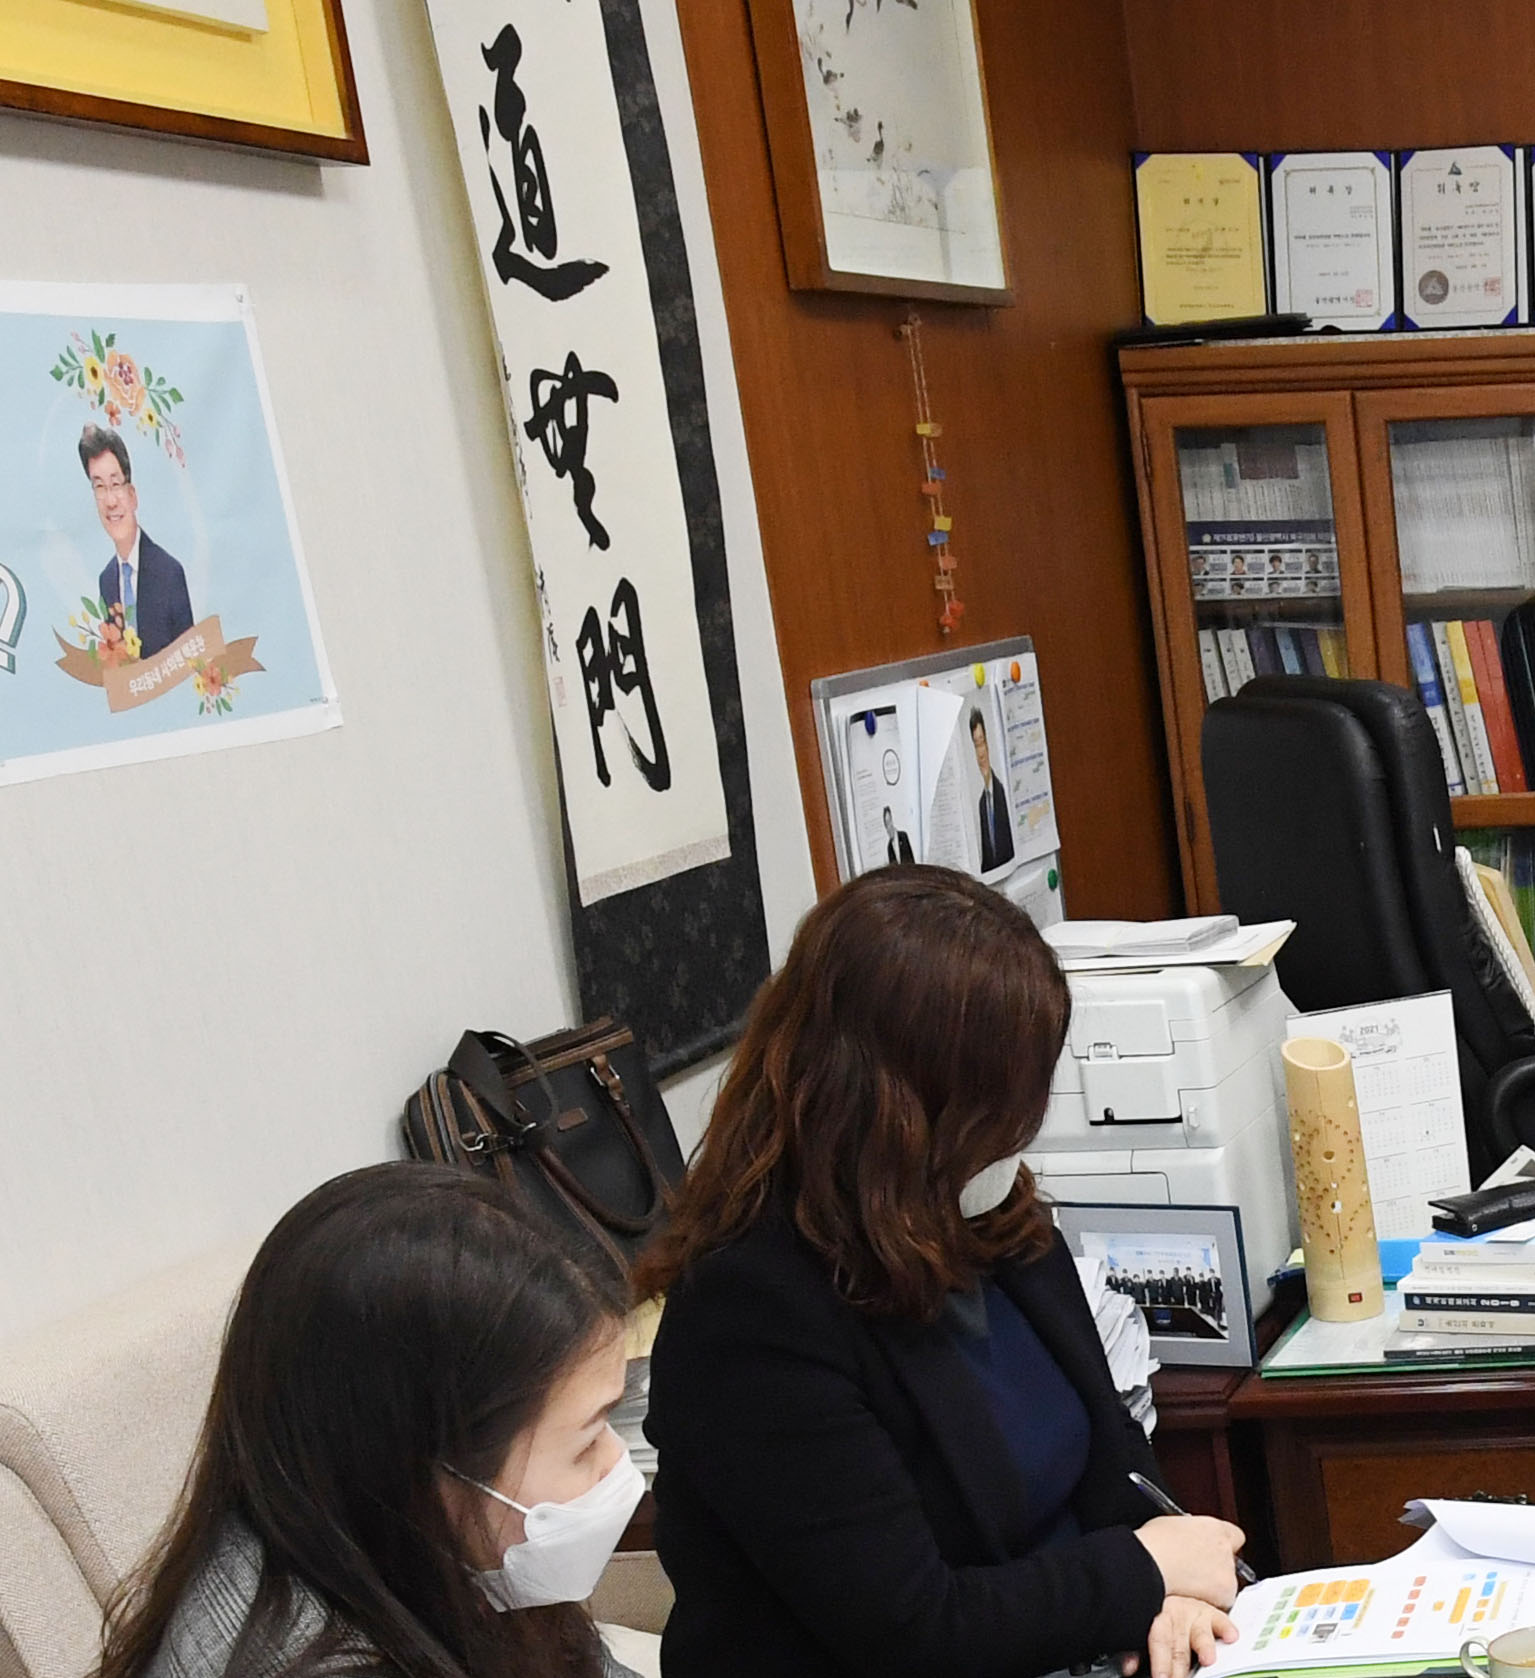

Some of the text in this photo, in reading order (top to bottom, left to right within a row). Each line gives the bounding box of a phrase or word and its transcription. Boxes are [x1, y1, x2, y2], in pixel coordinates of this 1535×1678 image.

[478, 0, 672, 792] 道無門
[1359, 1024, 1379, 1035] 2021
[1480, 1298, 1521, 1307] 2019
